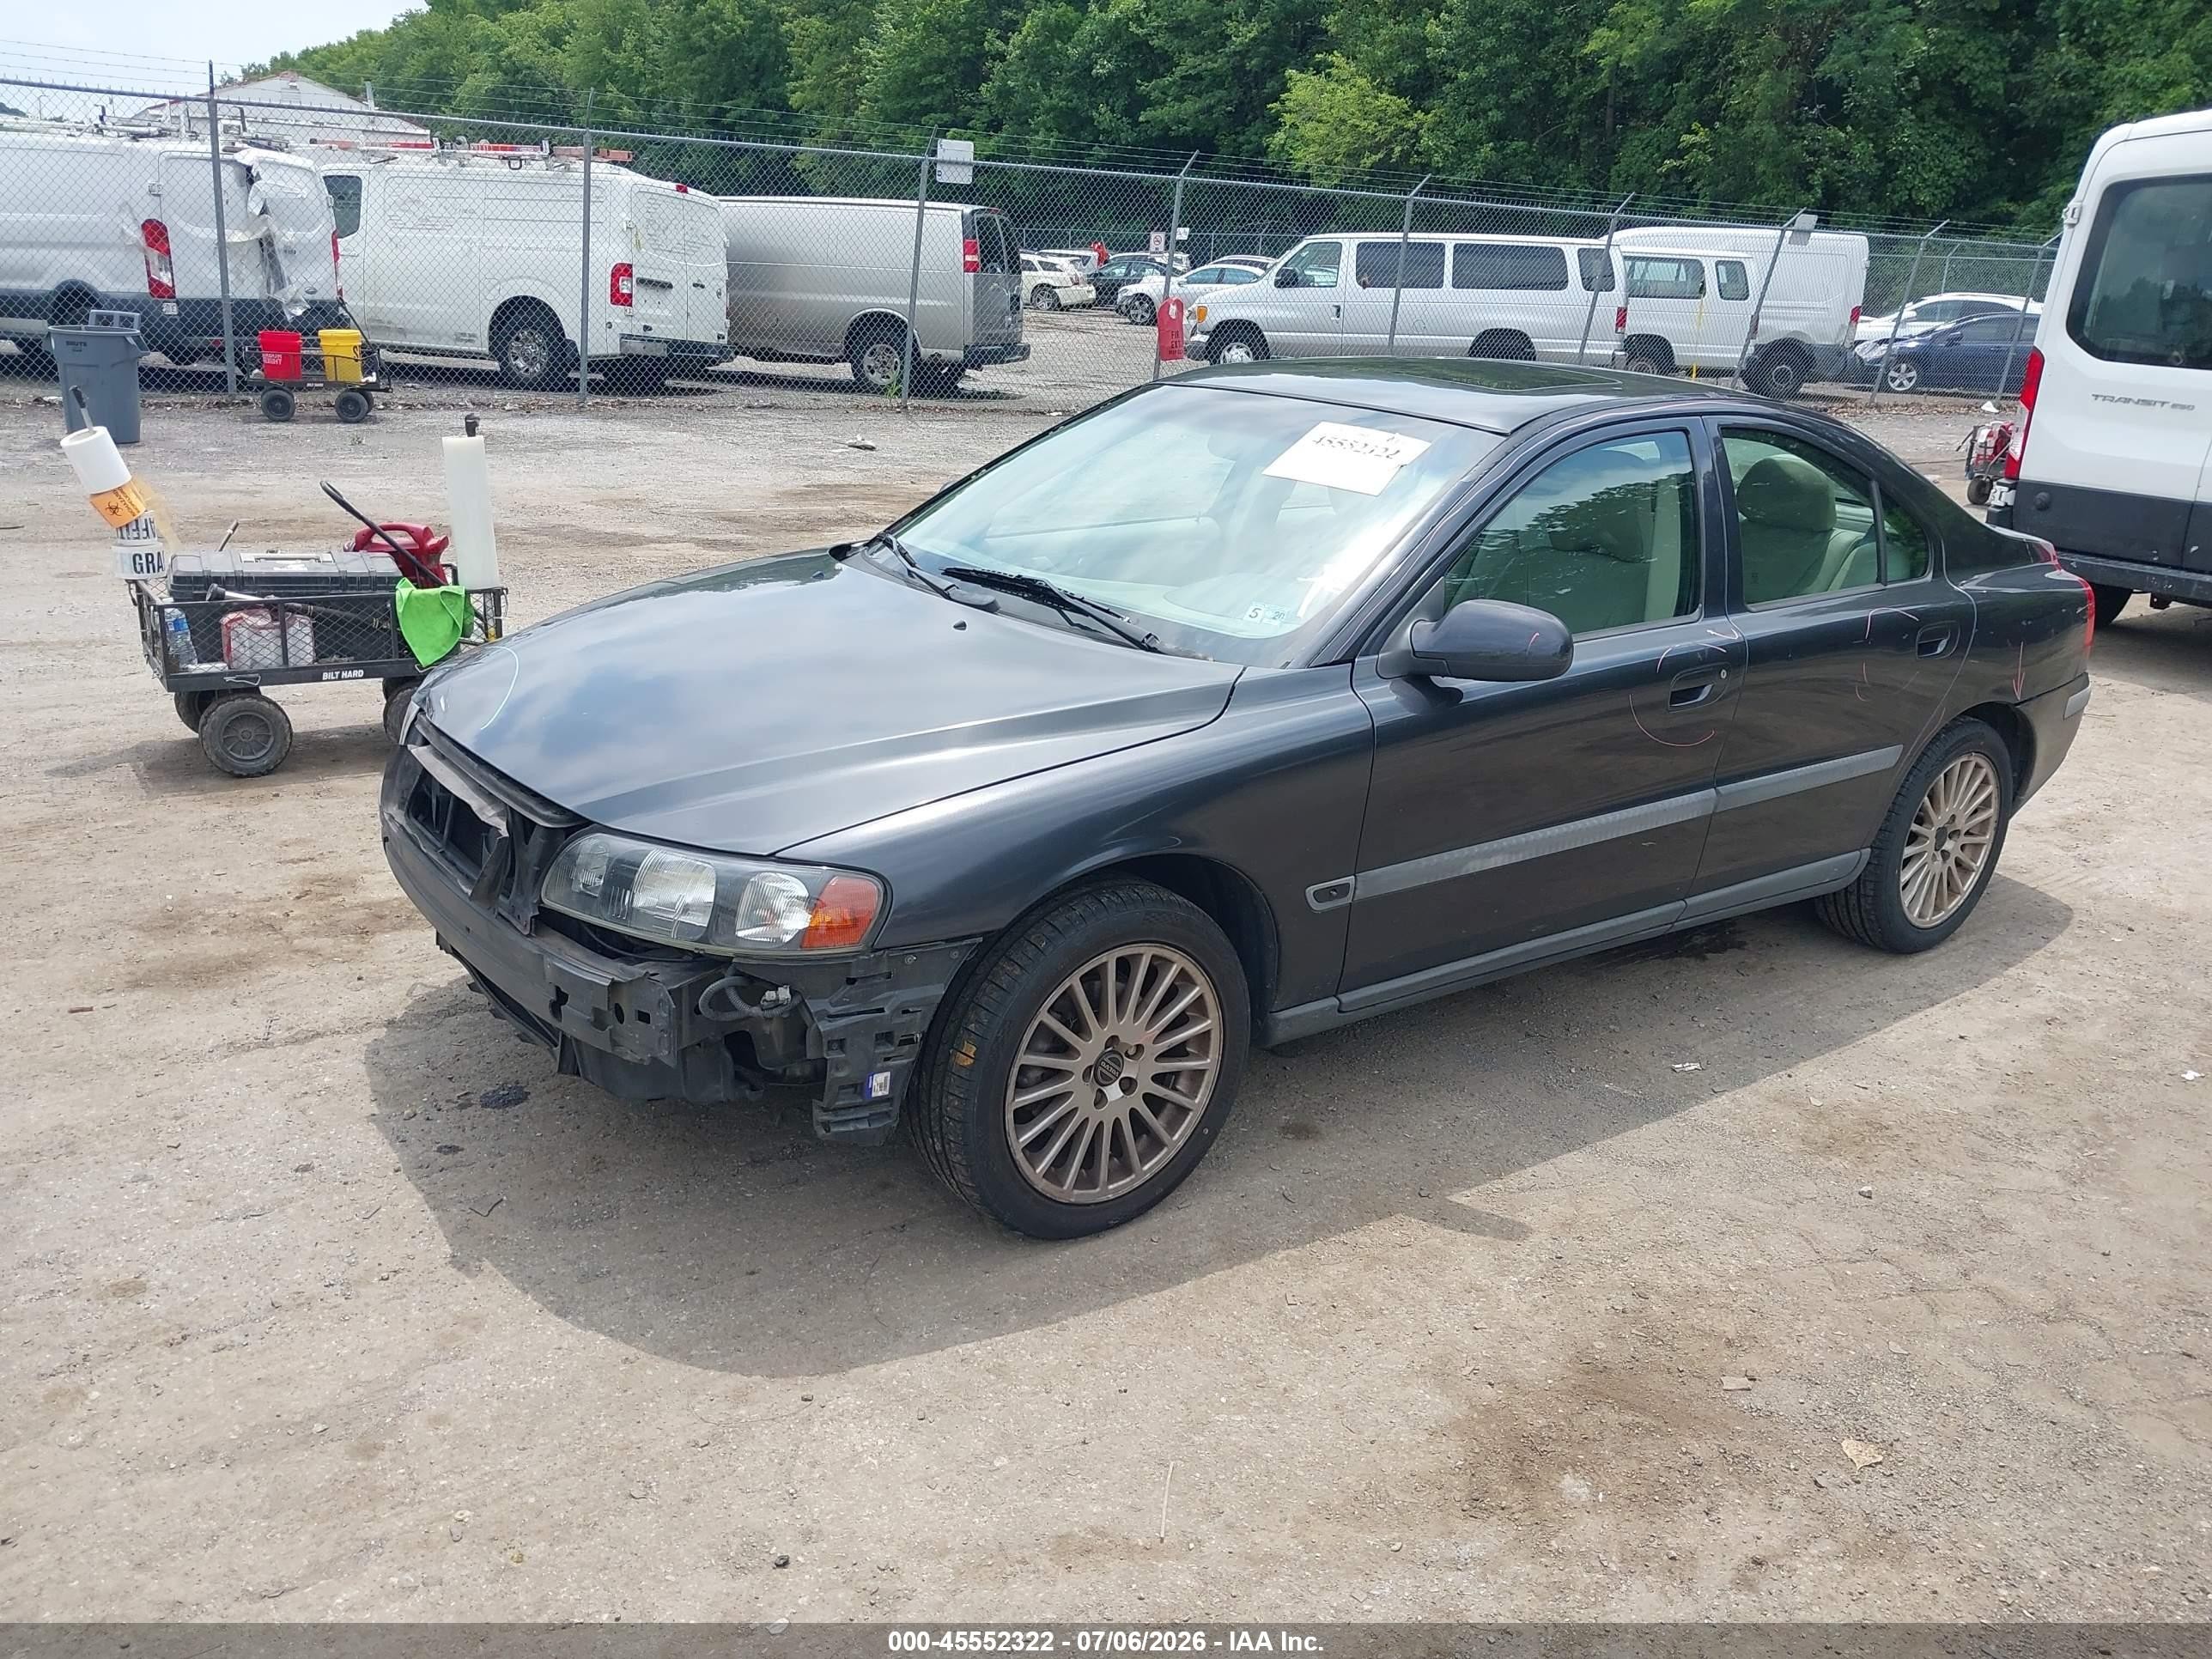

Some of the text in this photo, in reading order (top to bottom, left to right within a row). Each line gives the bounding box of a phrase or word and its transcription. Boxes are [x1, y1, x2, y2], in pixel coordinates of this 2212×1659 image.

[2091, 393, 2171, 408] TRANSIT
[132, 550, 165, 574] GRA
[1249, 607, 1262, 619] 5
[322, 669, 364, 680] BILT HARD
